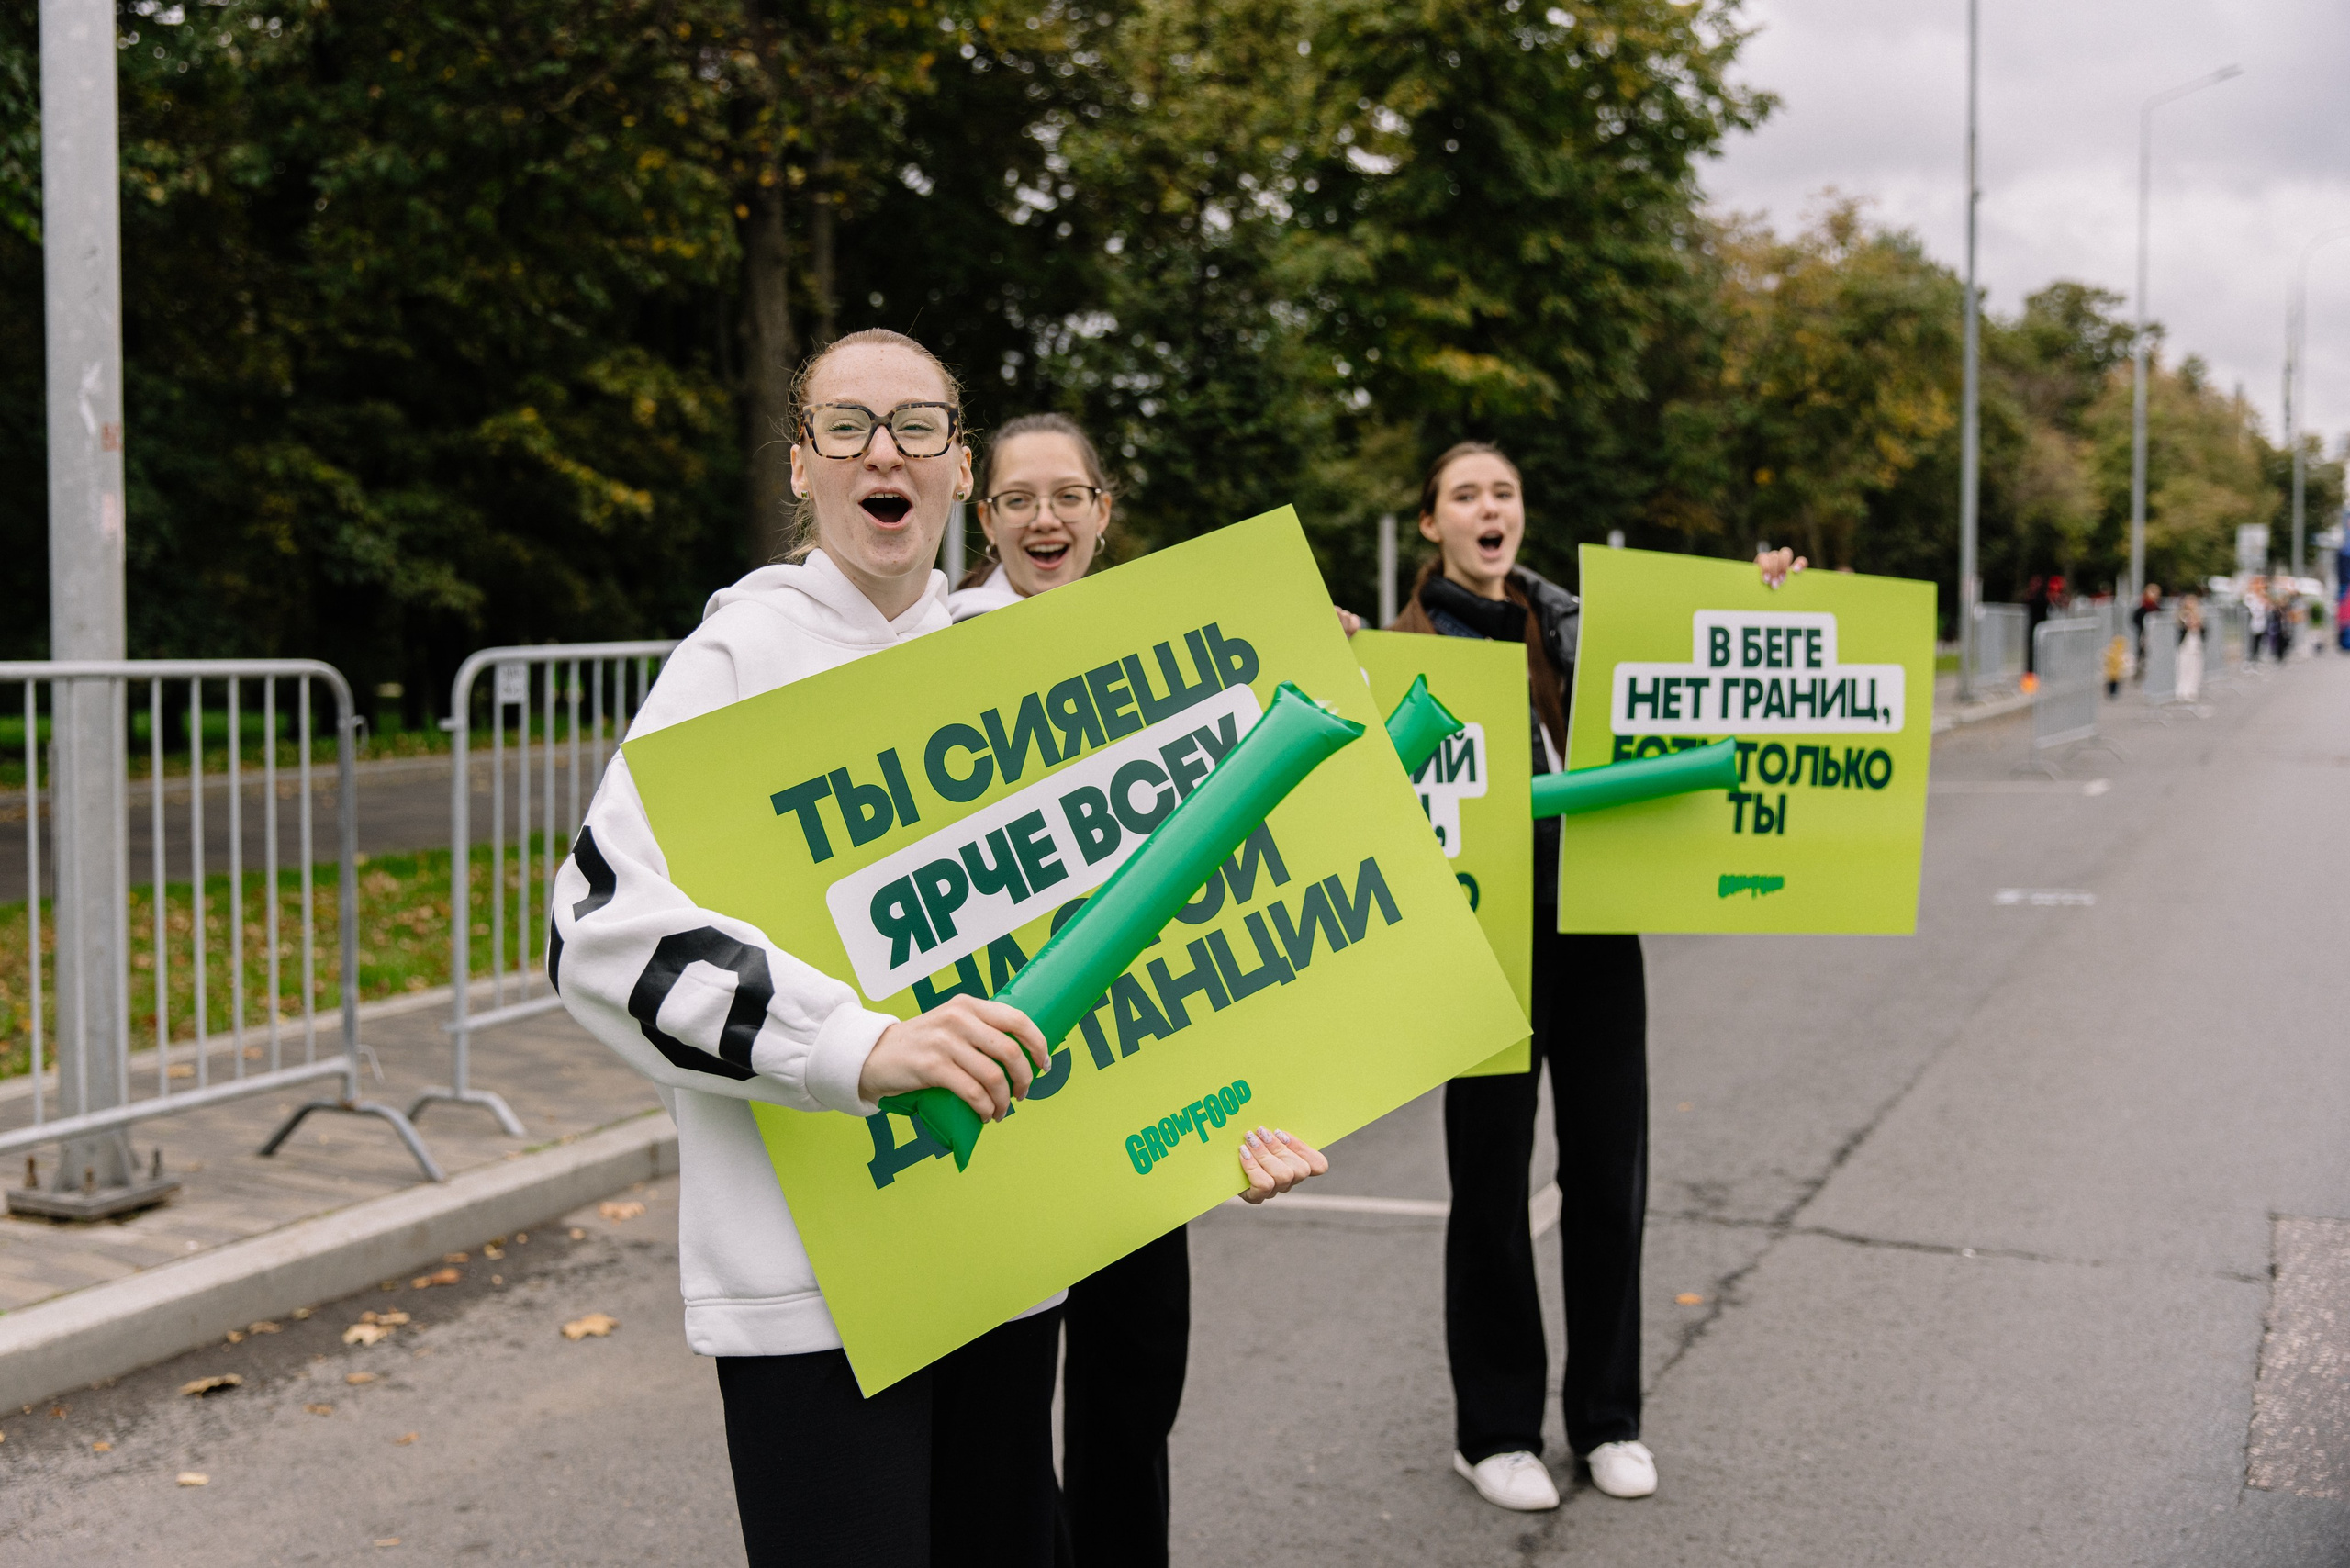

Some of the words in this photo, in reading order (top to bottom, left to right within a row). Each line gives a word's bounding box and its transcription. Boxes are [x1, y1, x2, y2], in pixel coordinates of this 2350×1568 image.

[1708, 626, 1731, 668] В
[1741, 626, 1822, 668] БЕГЕ
[1627, 677, 1710, 720] НЕТ
[1719, 678, 1891, 725] ГРАНИЦ,
[769, 747, 921, 865] ТЫ
[923, 622, 1260, 803] СИЯЕШЬ
[1736, 742, 1893, 790] ТОЛЬКО
[1728, 792, 1787, 834] ТЫ
[868, 810, 1069, 971] ЯРЧЕ
[867, 856, 1404, 1191] ДТАНЦИИ
[1125, 1079, 1252, 1176] GROWFOOD
